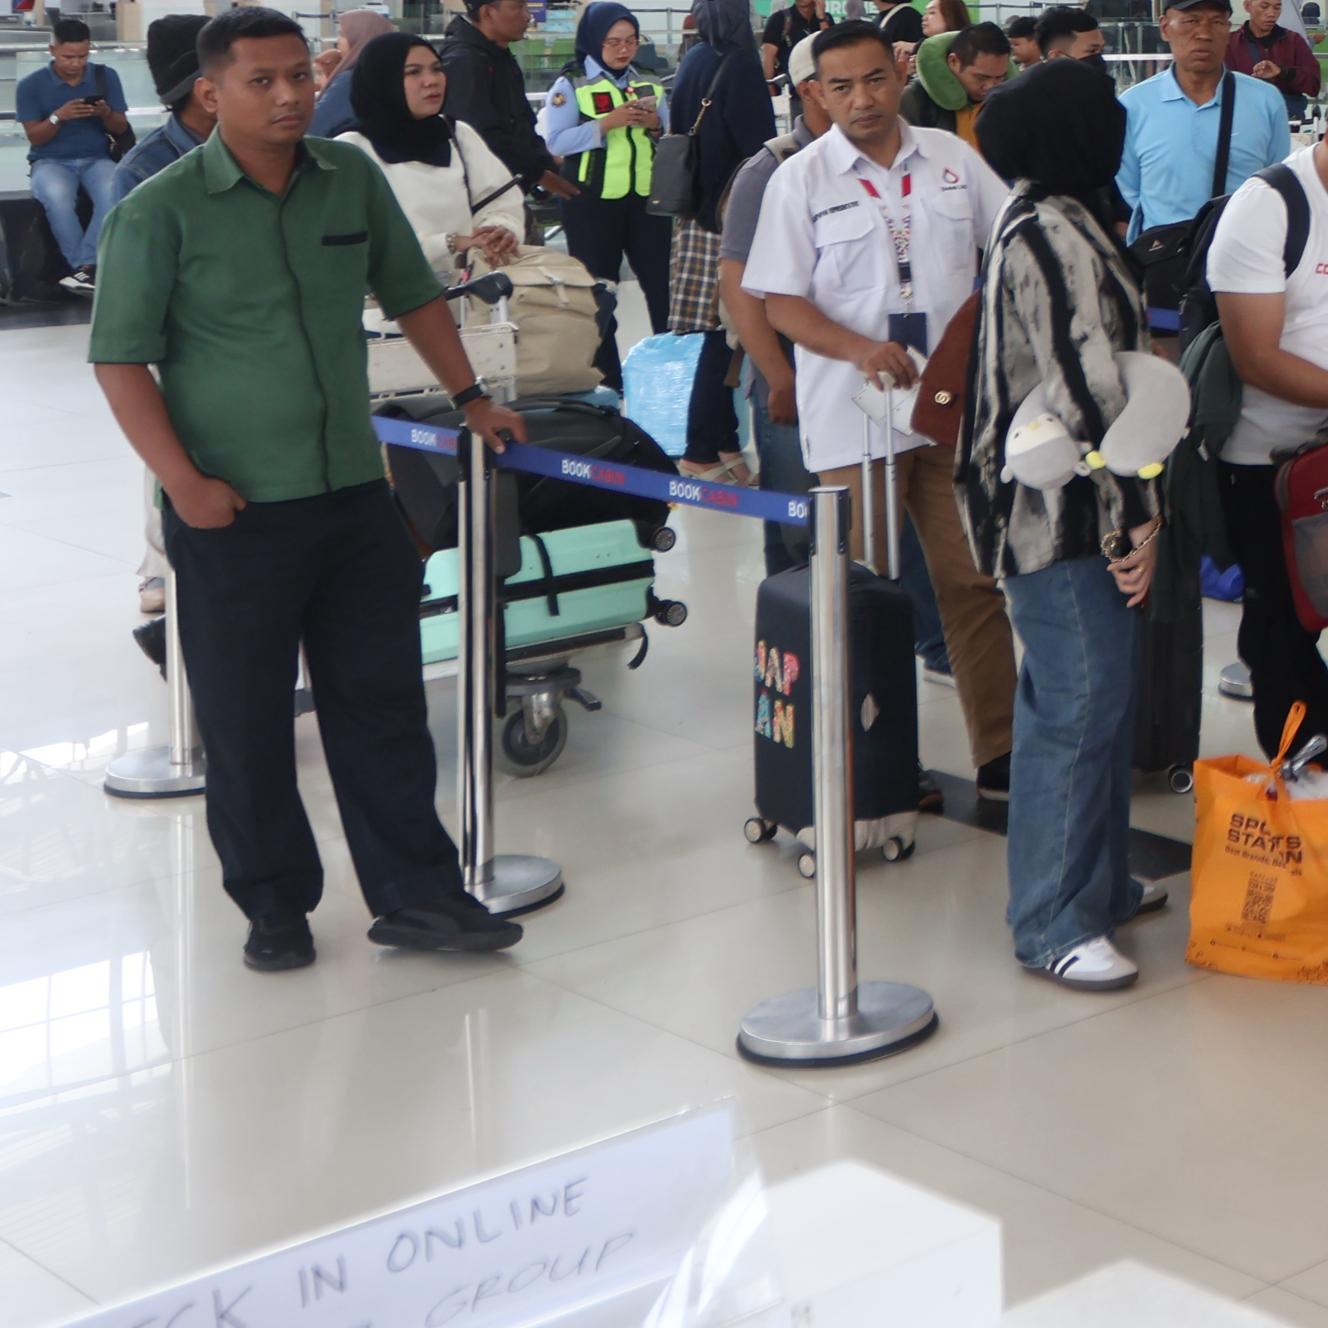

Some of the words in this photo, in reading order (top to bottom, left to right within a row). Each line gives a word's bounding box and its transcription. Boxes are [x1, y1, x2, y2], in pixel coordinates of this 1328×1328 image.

[754, 690, 795, 750] AN
[298, 1254, 348, 1309] IN
[385, 1176, 588, 1274] ONLINE
[424, 1228, 637, 1328] GROUP
